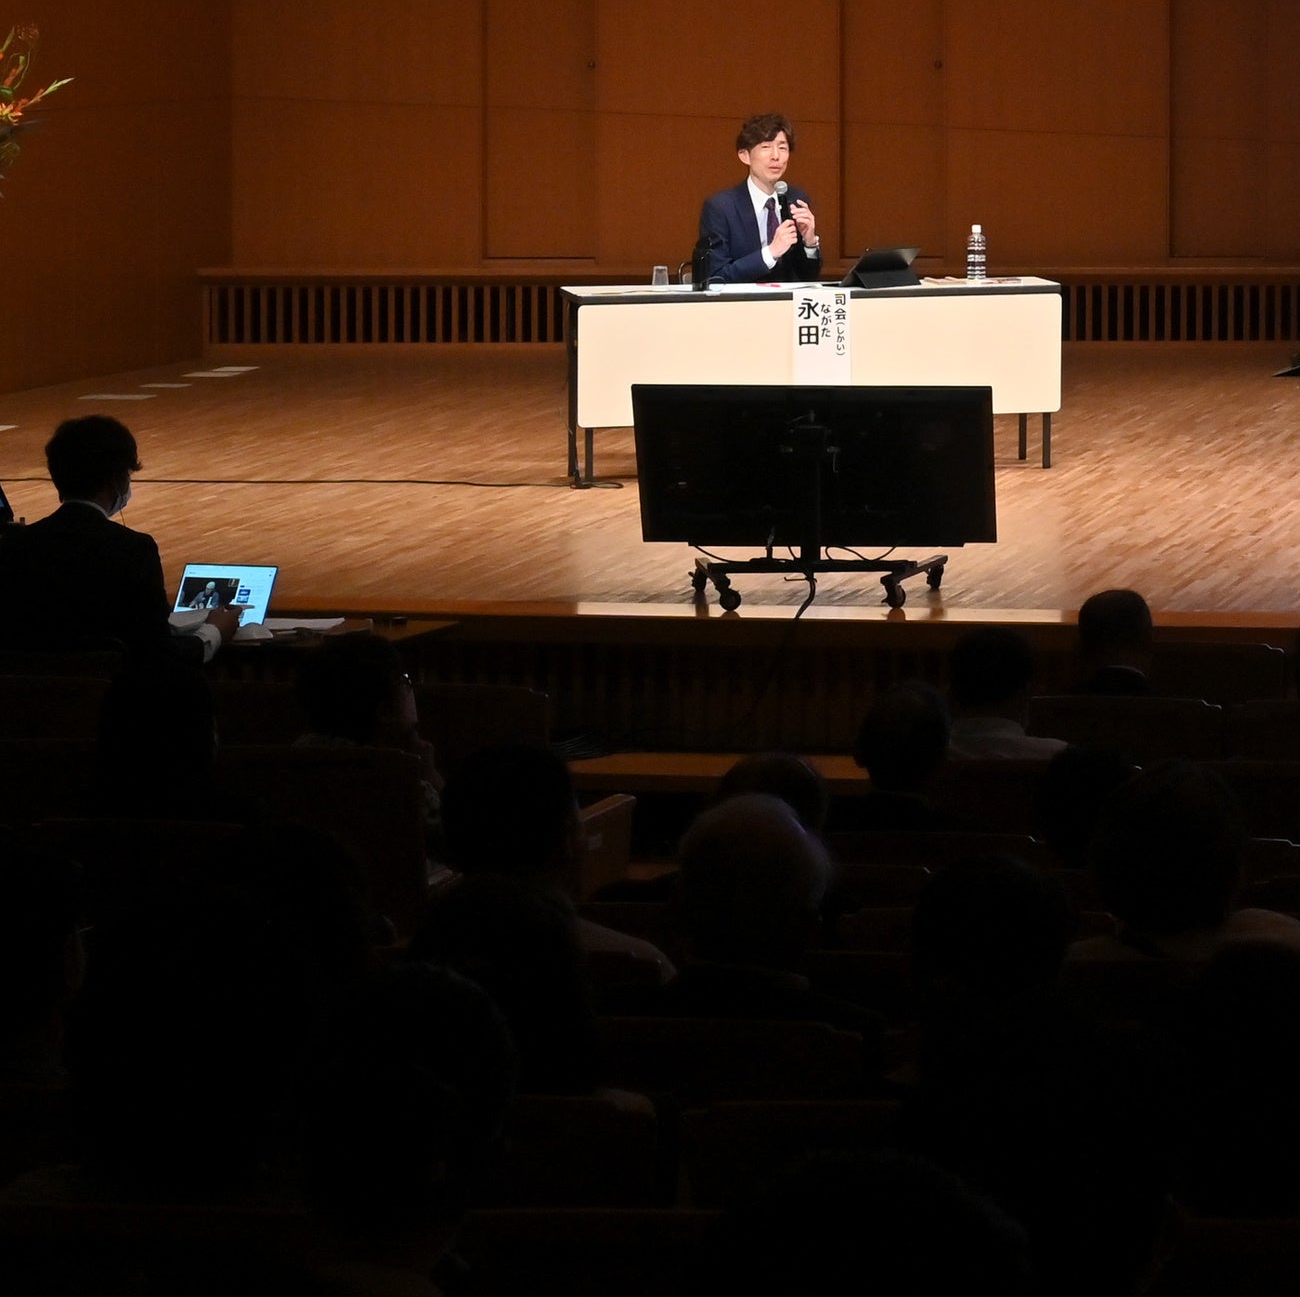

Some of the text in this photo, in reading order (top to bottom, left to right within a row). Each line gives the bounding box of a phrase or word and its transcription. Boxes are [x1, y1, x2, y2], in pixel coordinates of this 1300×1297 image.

[797, 298, 820, 345] 永田
[821, 304, 832, 338] ながた
